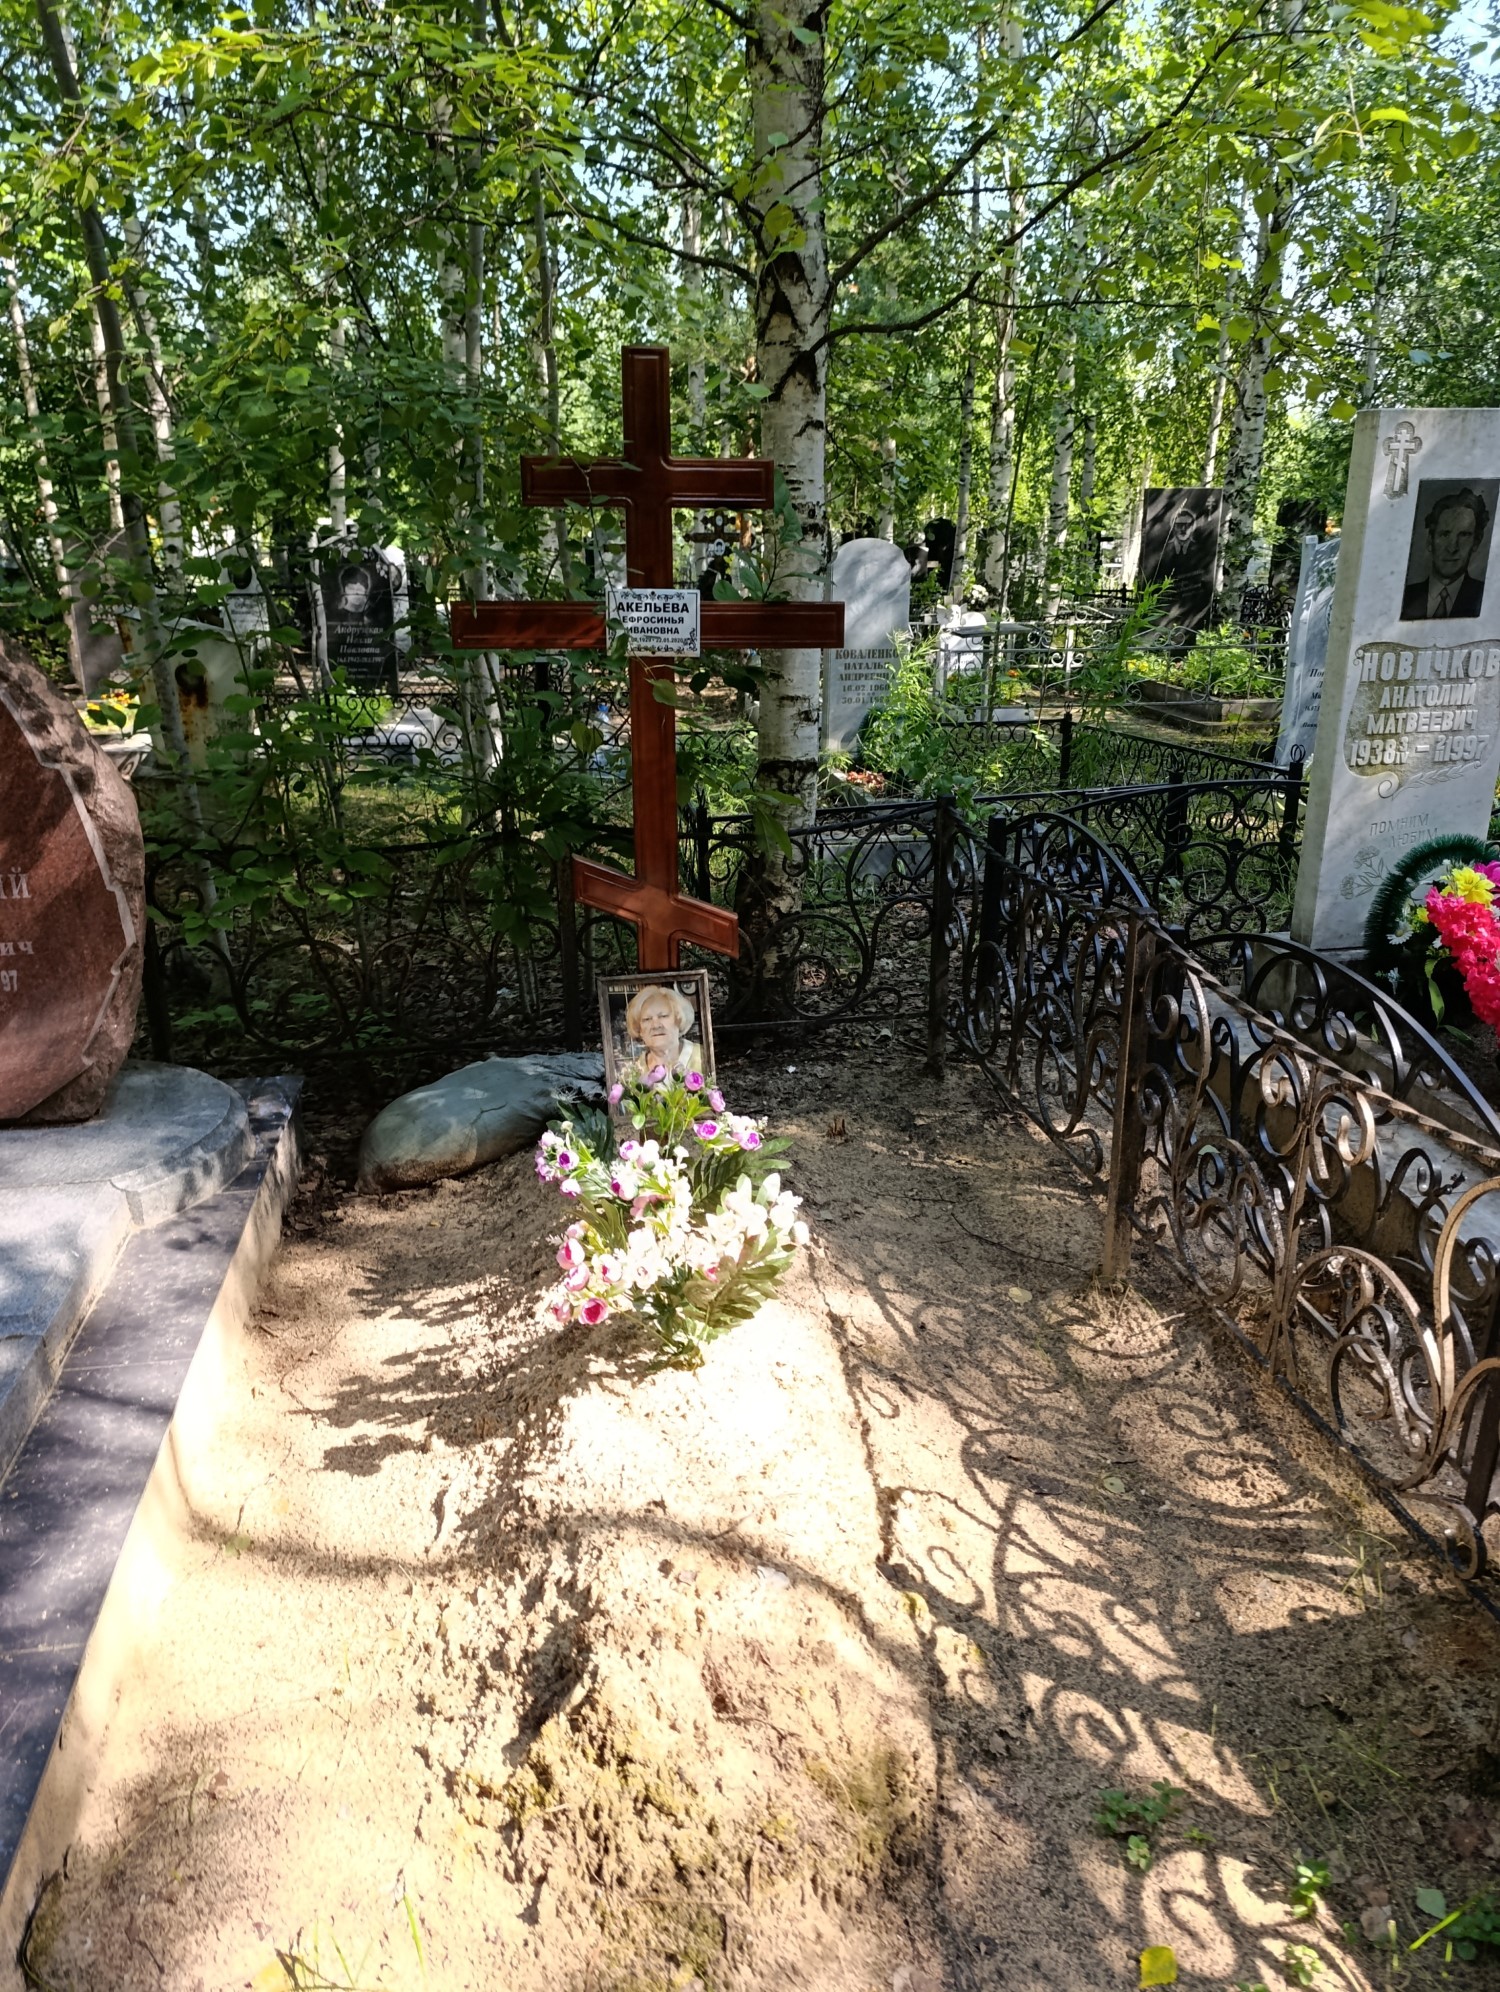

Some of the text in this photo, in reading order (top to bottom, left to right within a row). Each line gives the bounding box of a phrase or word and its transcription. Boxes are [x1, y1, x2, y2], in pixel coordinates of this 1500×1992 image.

[617, 602, 689, 613] АКЕЛЬЕВА
[622, 616, 684, 624] ЕФРОСИНЬЯ
[835, 648, 899, 660] КОВАЛЕНКО
[1361, 649, 1500, 682] НОВИЧКОВ
[1379, 679, 1477, 709] АНАТОЛИЙ
[1366, 709, 1479, 735] МАТВЕЕВИЧ
[1349, 738, 1397, 767] 1938
[1369, 813, 1430, 837] ПОМНИМ
